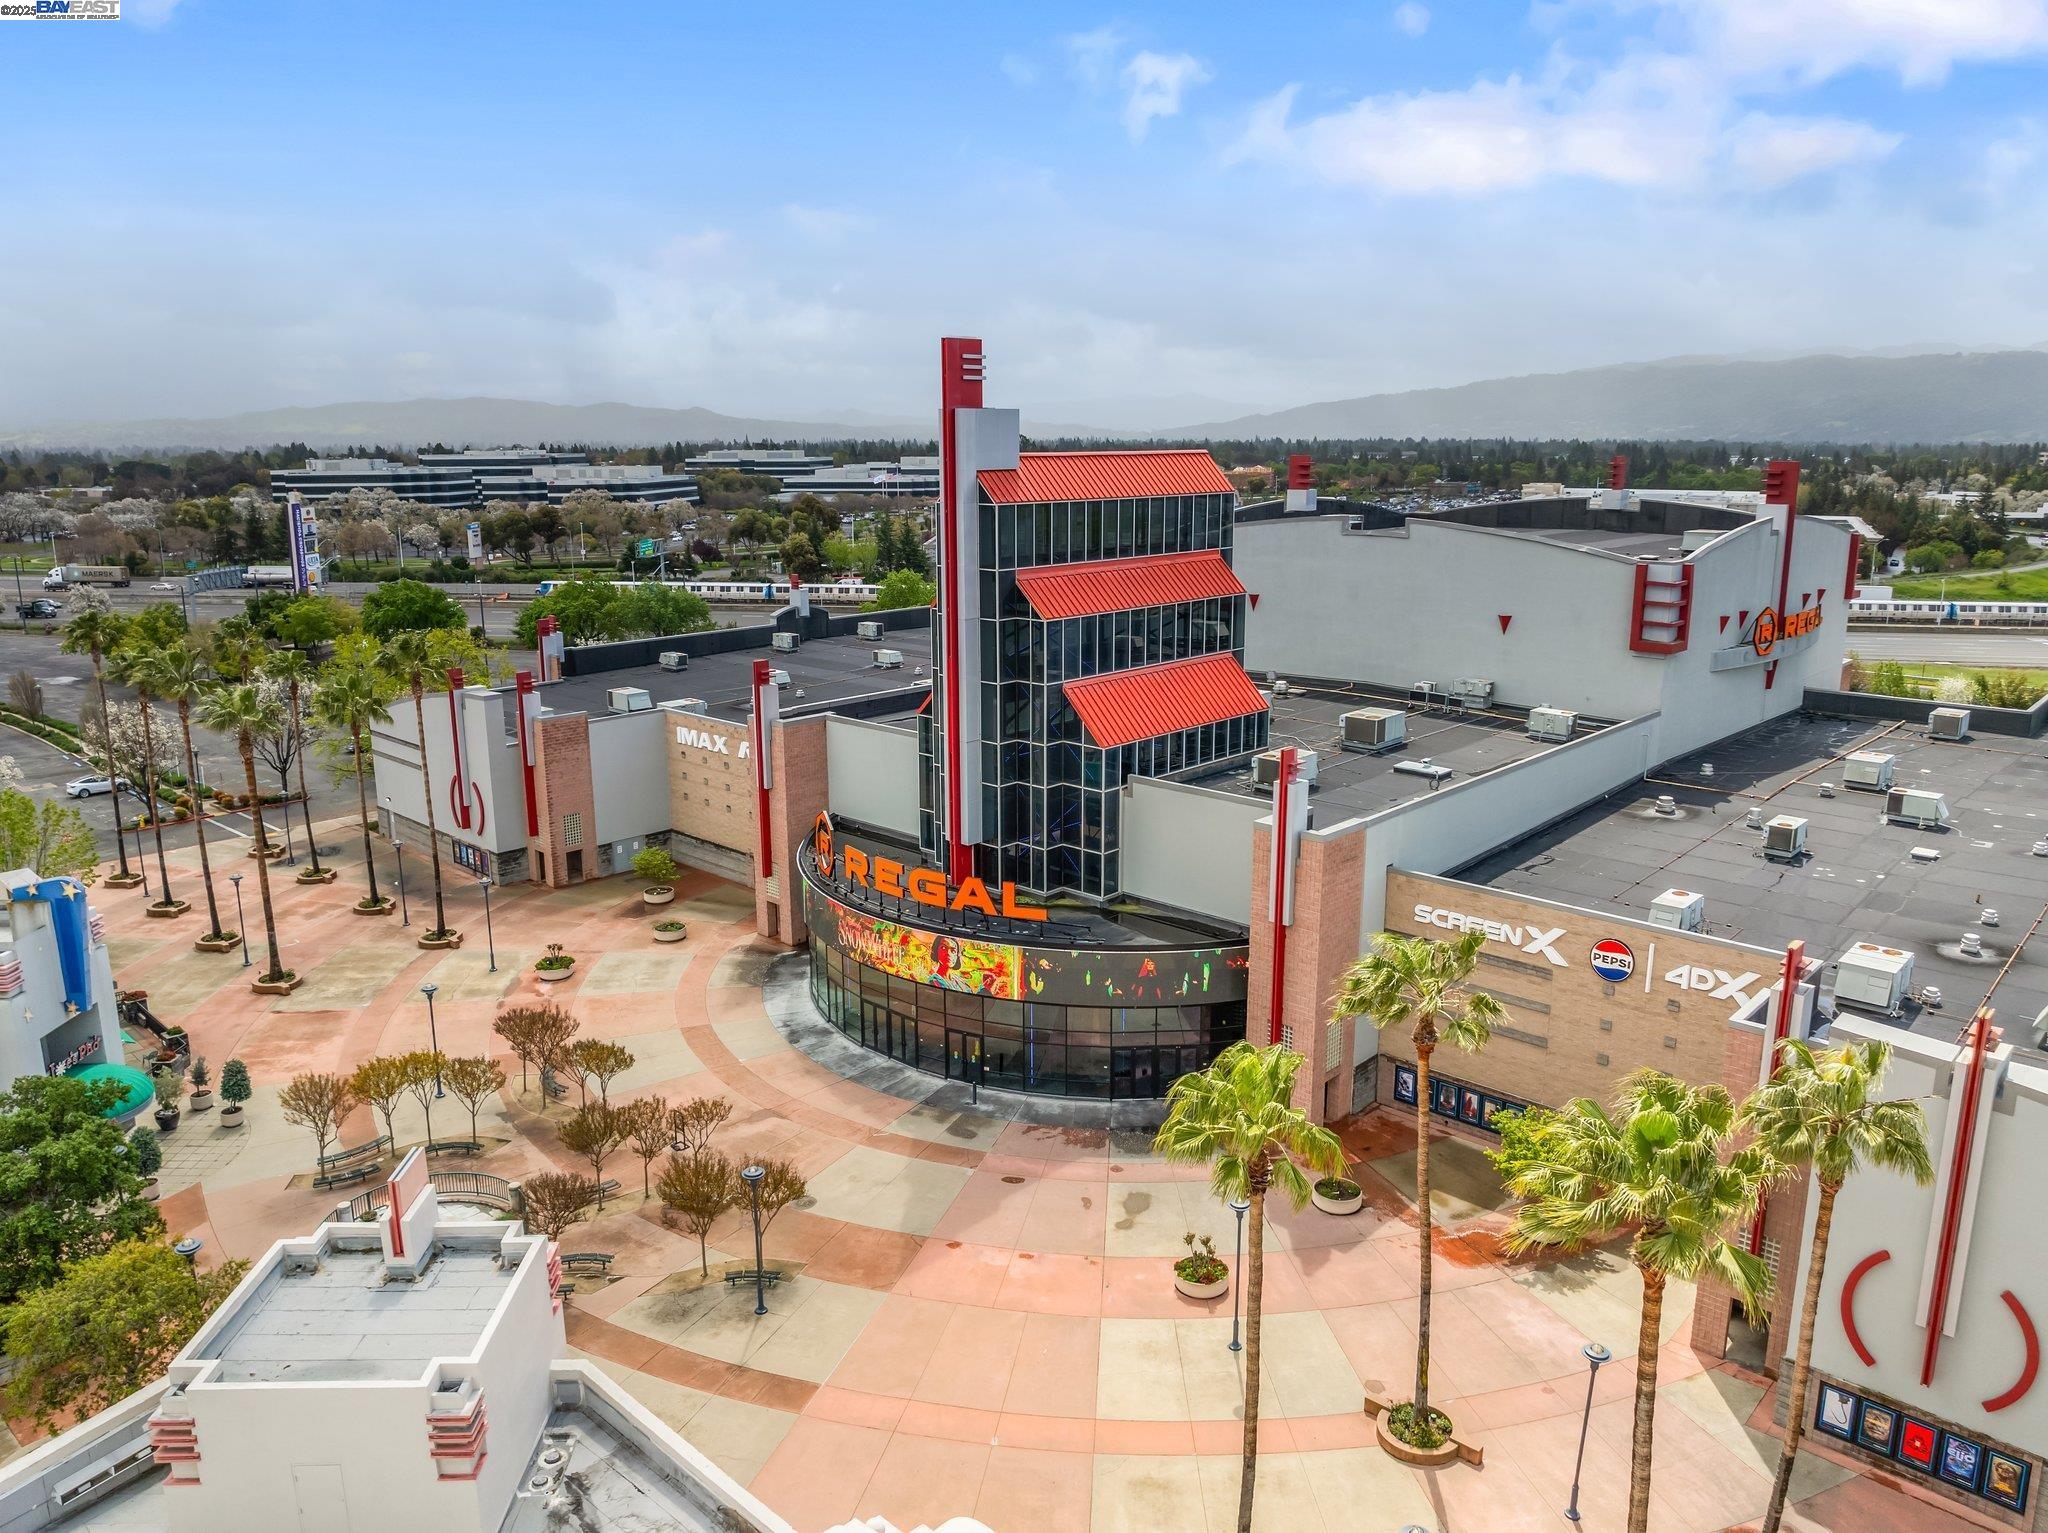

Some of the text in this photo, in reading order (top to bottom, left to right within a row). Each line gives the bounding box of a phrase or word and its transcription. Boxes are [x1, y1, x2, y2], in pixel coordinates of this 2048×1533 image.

[676, 726, 729, 755] IMAX
[844, 845, 1049, 922] REGAL
[1593, 952, 1632, 970] PEPSI
[1664, 964, 1762, 1008] 4DX
